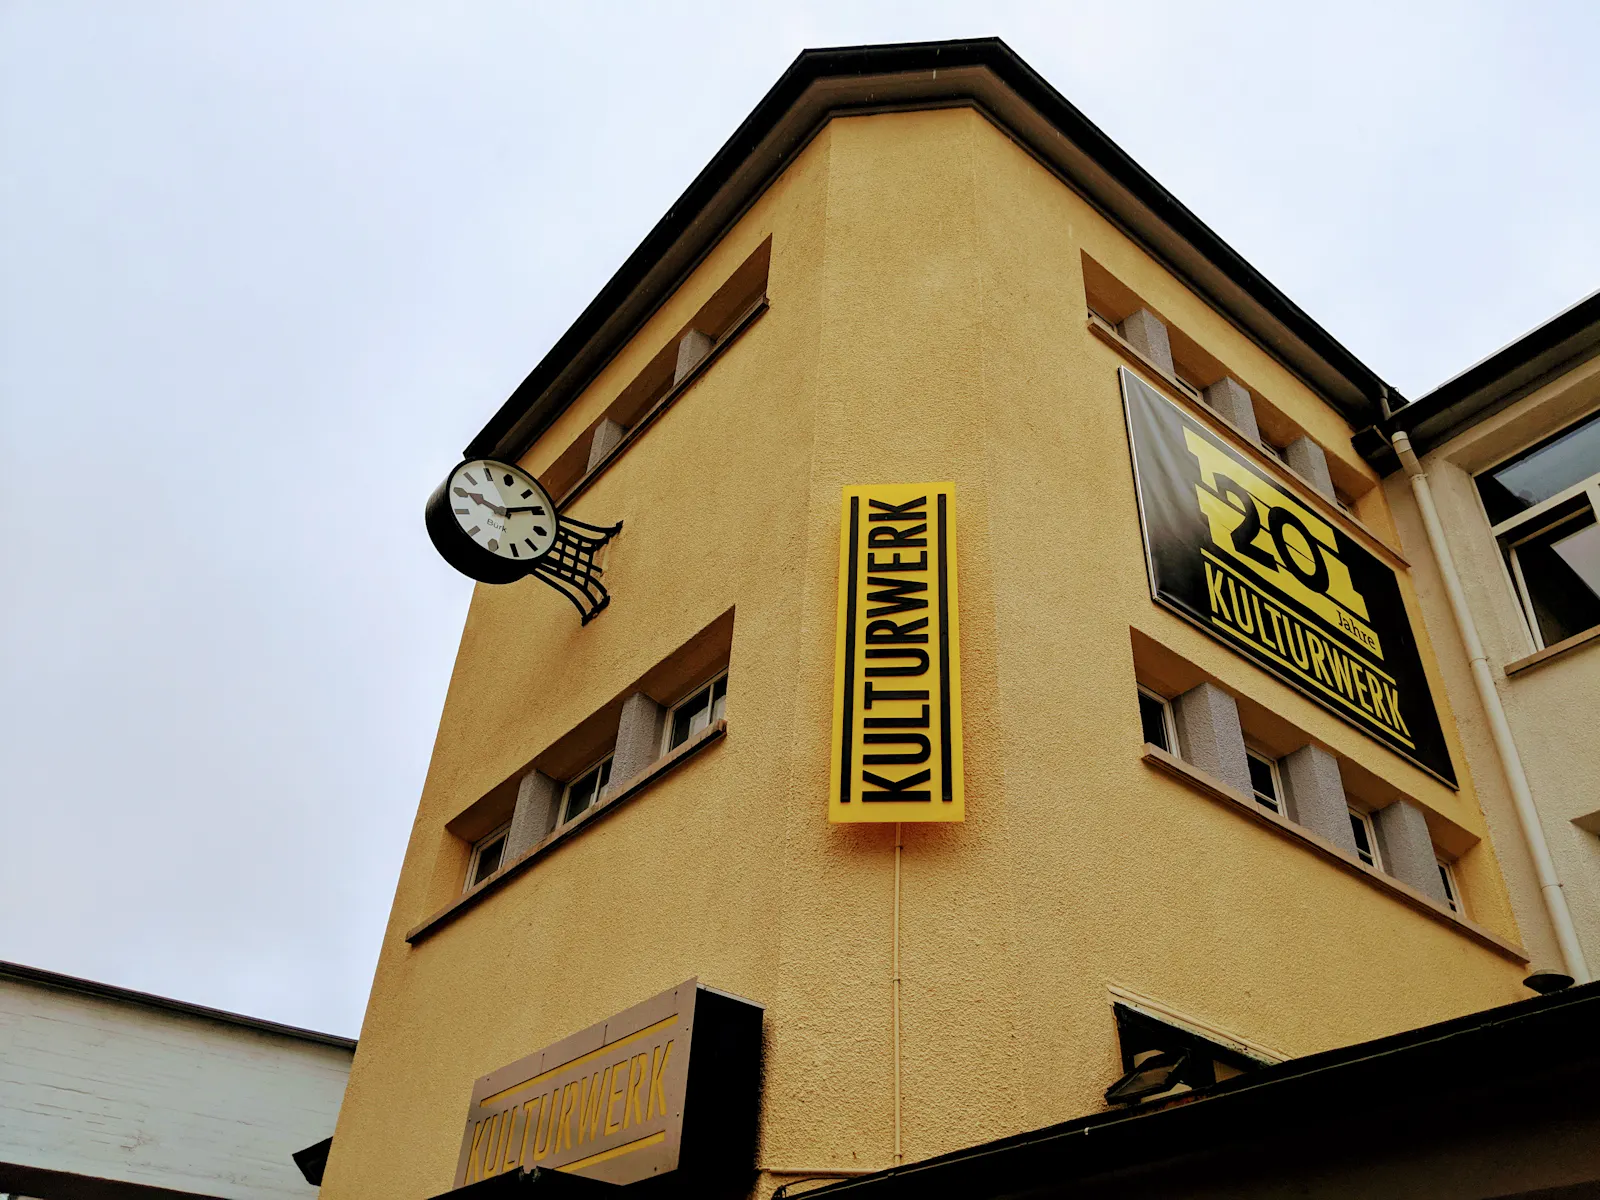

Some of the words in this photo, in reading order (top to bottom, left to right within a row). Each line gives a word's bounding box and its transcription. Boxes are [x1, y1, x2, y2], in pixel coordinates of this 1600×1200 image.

[486, 518, 507, 533] Bürk
[1214, 471, 1330, 594] 20
[861, 495, 931, 803] KULTURWERK
[1204, 561, 1410, 738] KULTURWERK
[1336, 609, 1376, 650] Jahre
[463, 1038, 675, 1186] KULTURWERK
